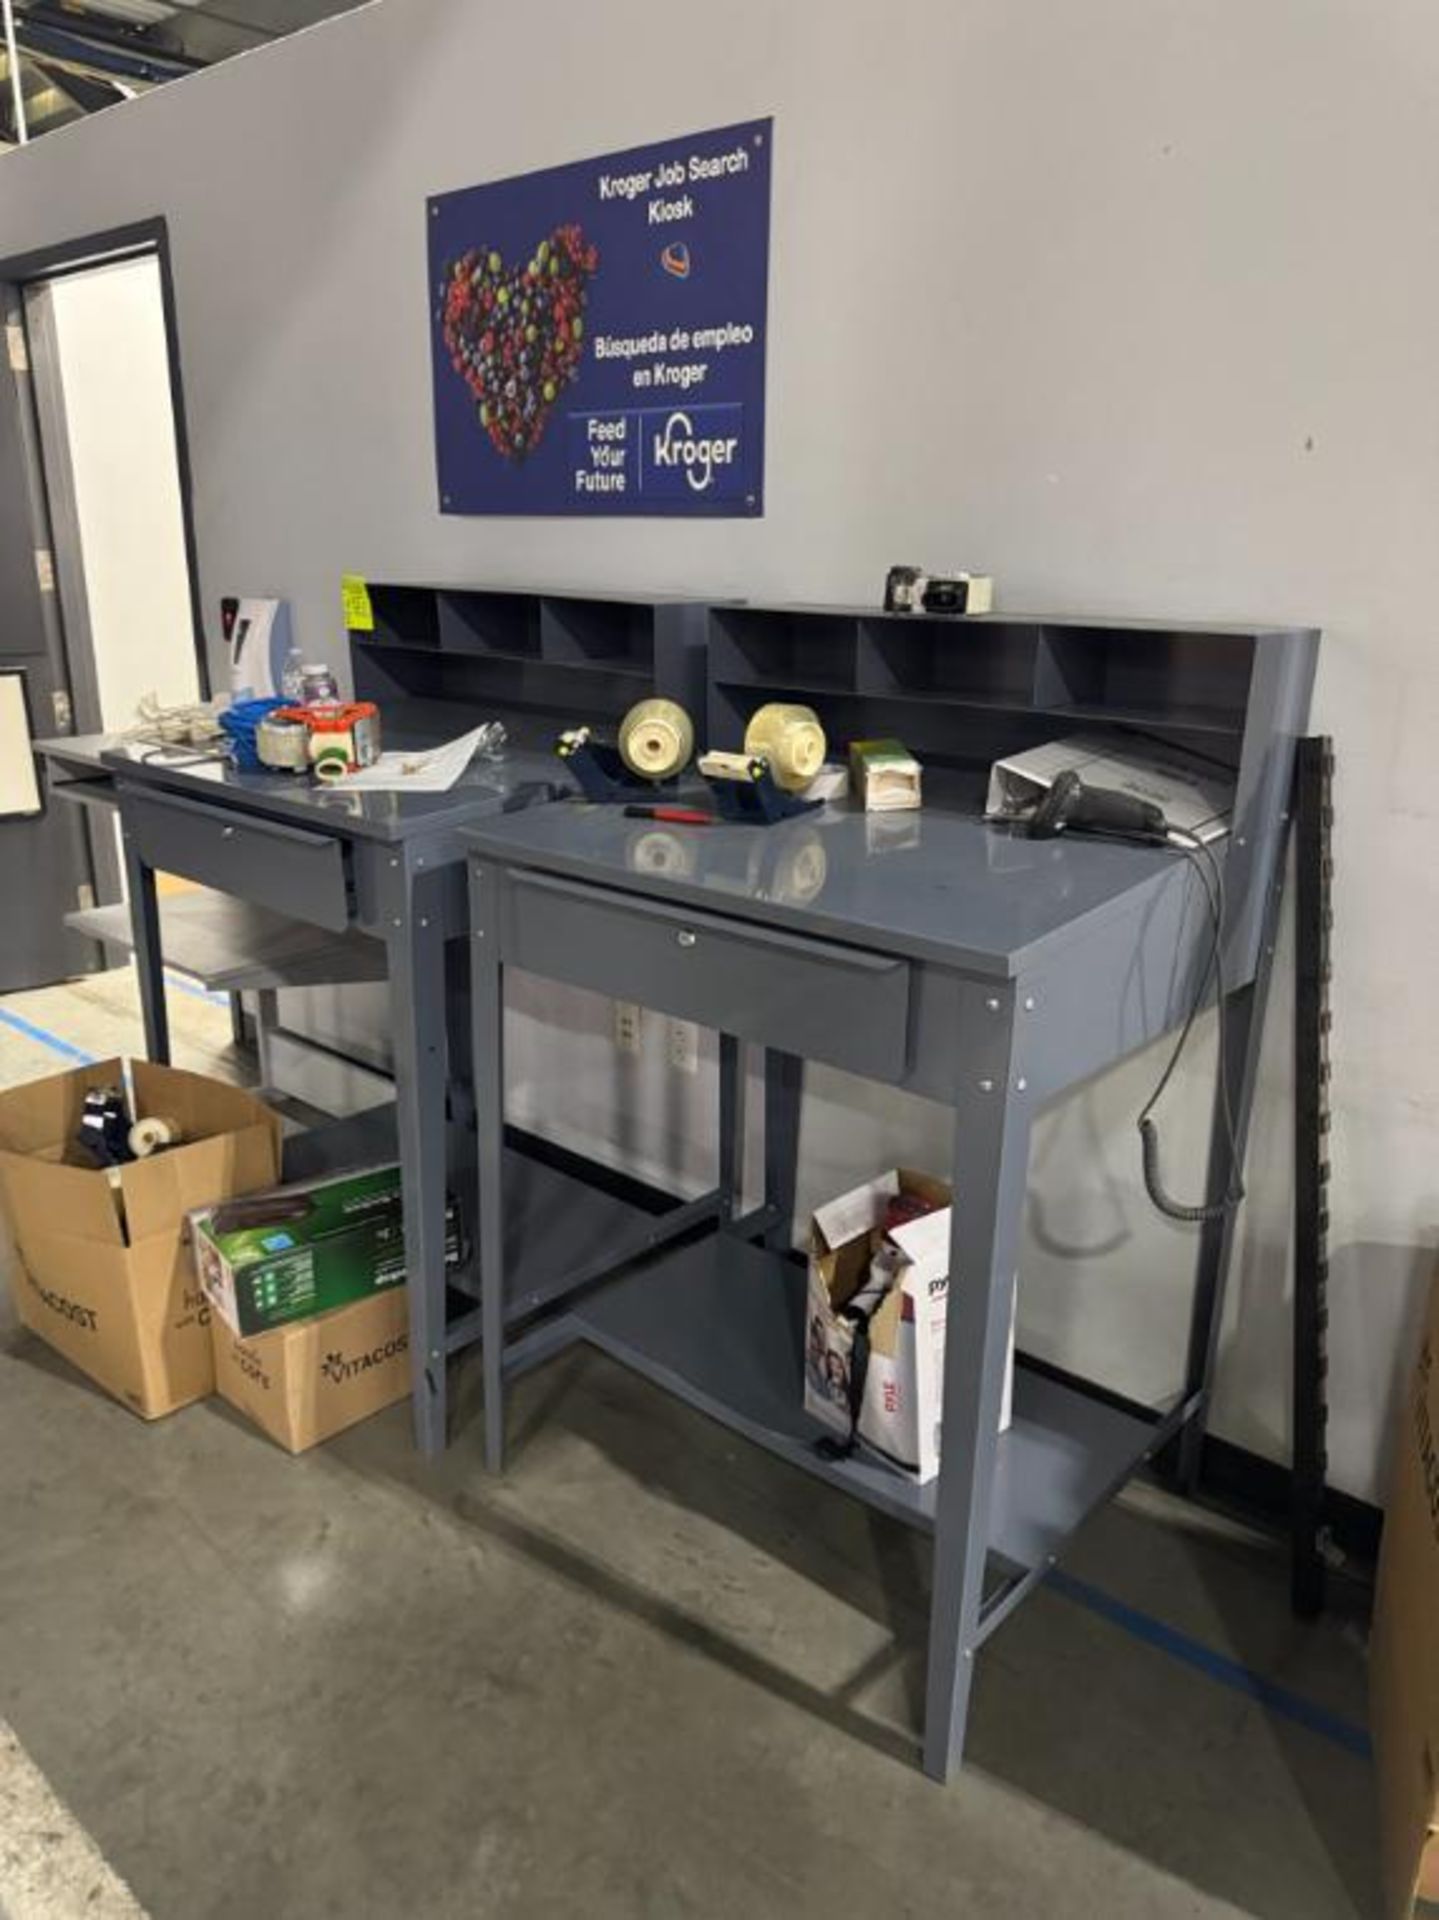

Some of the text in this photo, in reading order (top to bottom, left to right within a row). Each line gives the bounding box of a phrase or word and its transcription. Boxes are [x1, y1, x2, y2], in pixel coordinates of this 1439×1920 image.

[599, 147, 748, 200] Kroger Job Search
[648, 194, 693, 225] Kiosk
[595, 322, 753, 360] Búsqueda de empleo
[633, 362, 708, 389] en Kroger
[588, 417, 625, 441] Feed
[591, 445, 625, 467] Your
[654, 412, 738, 491] Kroger
[575, 469, 625, 492] Future
[330, 1334, 410, 1385] VITACOS
